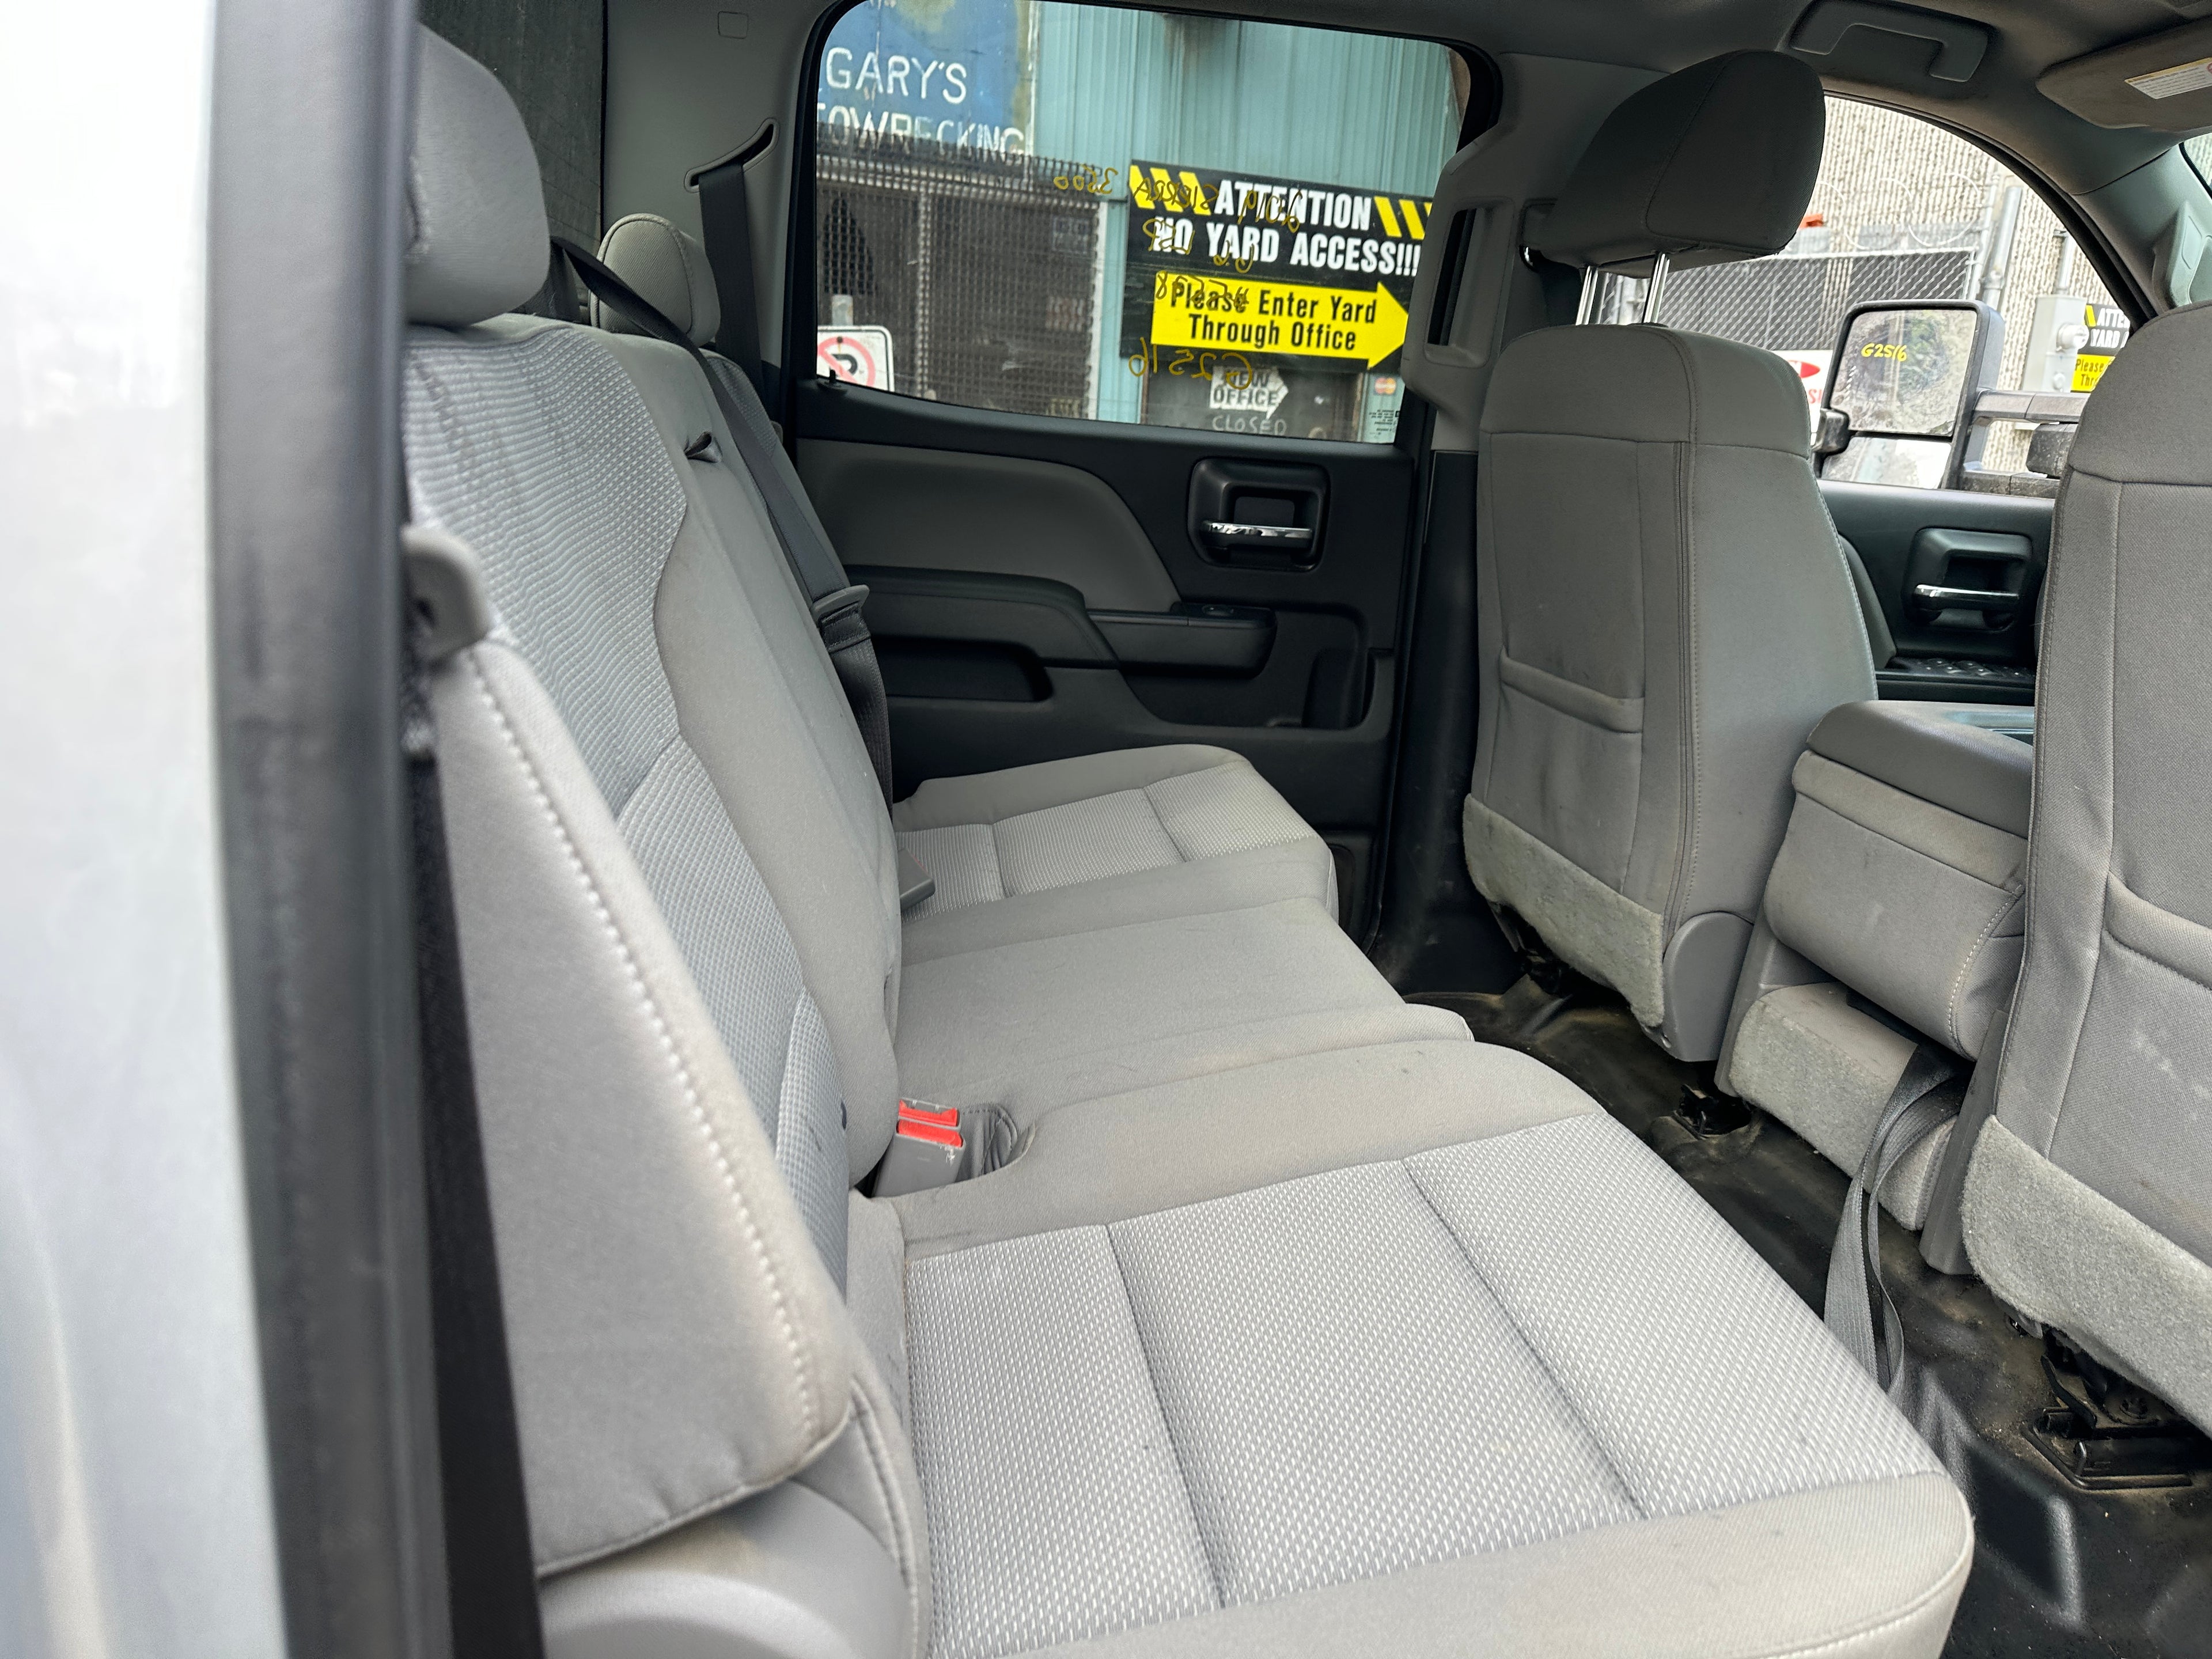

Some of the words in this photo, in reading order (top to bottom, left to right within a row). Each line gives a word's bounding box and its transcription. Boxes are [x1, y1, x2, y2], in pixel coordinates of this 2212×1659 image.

[826, 47, 968, 104] GARY'S
[1214, 180, 1373, 230] ATTENTION
[1153, 216, 1194, 255] NO
[1206, 222, 1280, 263] YARD
[1289, 232, 1421, 276] ACCESS!!!
[1171, 278, 1248, 311] Please
[1259, 289, 1319, 319] Enter
[1331, 296, 1377, 324] Yard
[1189, 313, 1280, 349] Through
[1291, 321, 1357, 351] Office
[2090, 329, 2120, 349] YARD
[1861, 343, 1908, 362] G2516
[2075, 358, 2104, 373] Please
[1213, 385, 1278, 406] OFFICE
[1212, 414, 1287, 436] CLOSED
